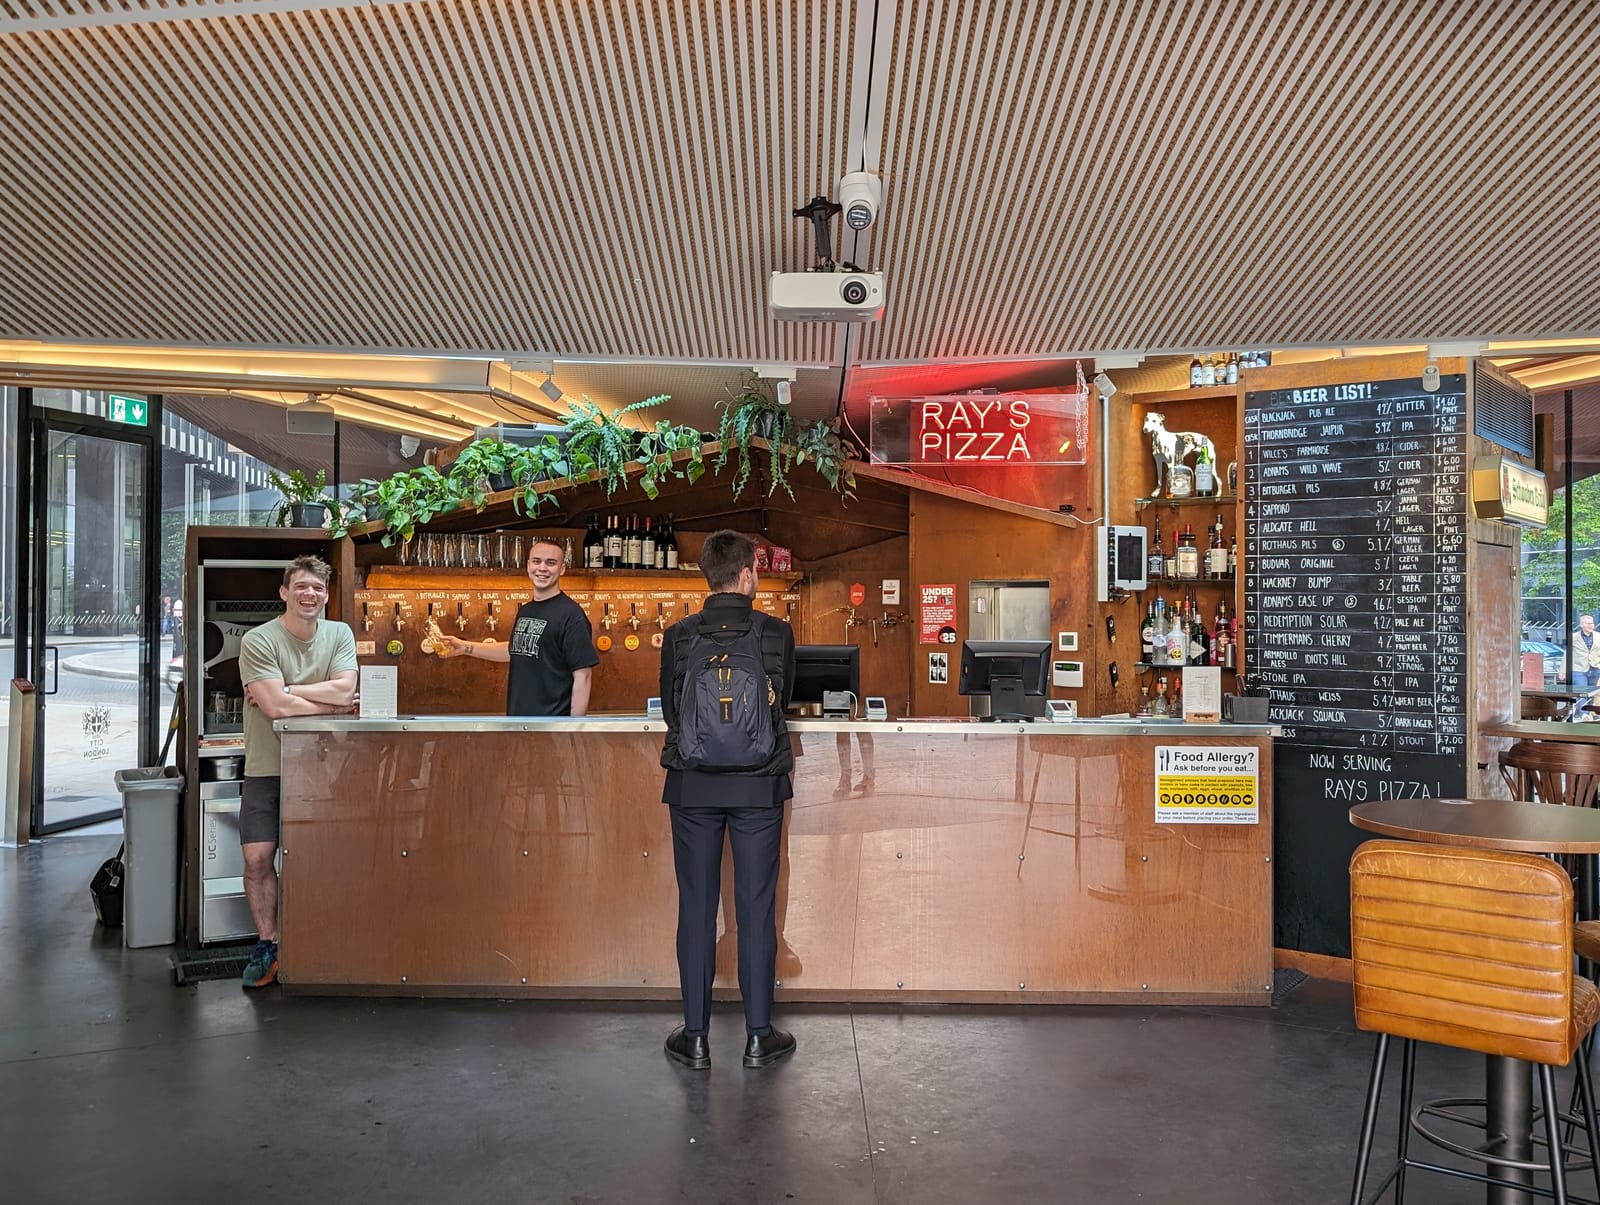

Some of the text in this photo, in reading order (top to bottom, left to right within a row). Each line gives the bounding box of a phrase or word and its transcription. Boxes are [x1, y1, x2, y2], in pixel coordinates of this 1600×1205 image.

[1293, 384, 1372, 404] BEER LIST!
[922, 400, 1031, 429] RAY'S
[1261, 411, 1296, 423] BLACKJACK
[1309, 408, 1322, 418] PUB
[1396, 400, 1425, 412] BITTER
[1261, 427, 1308, 441] THORNBRIDGE
[1401, 421, 1414, 432] IPA
[922, 432, 1031, 460] PIZZA
[1400, 441, 1420, 451] CIDER
[1249, 469, 1255, 479] 2
[1300, 464, 1317, 474] WILD
[1322, 463, 1342, 473] WAVE
[1378, 460, 1390, 473] 5%
[1398, 460, 1421, 470] CIDER
[1249, 486, 1255, 496] 3
[1262, 484, 1297, 496] BITBURGER
[1305, 483, 1320, 494] PILS
[1248, 505, 1255, 517] 4
[1377, 500, 1392, 513] 5%
[1398, 504, 1420, 513] LAGER
[1249, 524, 1255, 535] 5
[1263, 522, 1293, 533] ALDGATE
[1300, 521, 1317, 532] HELL
[1395, 516, 1410, 525] HELL
[1402, 525, 1425, 533] LAGER
[1249, 542, 1255, 551] 6
[1262, 540, 1297, 551] ROTHAUS
[1301, 539, 1317, 550] PILS
[1394, 536, 1420, 544] GERMAN
[1262, 558, 1291, 570] BUDVAR
[1300, 557, 1336, 569] ORIGINAL
[1262, 577, 1297, 589] HACKNEY
[1308, 576, 1332, 589] BUMP
[1378, 578, 1392, 591] 3%
[1401, 575, 1423, 583] TABLE
[1401, 584, 1420, 592] BEER
[922, 587, 953, 596] UNDER
[922, 595, 938, 604] 25?
[1247, 596, 1254, 607] 9
[1263, 595, 1294, 608] ADNAMS
[1298, 595, 1318, 607] EASE
[1322, 595, 1334, 607] UP
[1396, 596, 1427, 604] SESSION
[1407, 604, 1419, 613] IPA
[1246, 615, 1256, 624] 10
[1263, 614, 1312, 628] REDEMPTION
[1320, 614, 1348, 628] SOLAR
[1394, 618, 1410, 627] PALE
[1413, 618, 1425, 627] ALE
[942, 632, 956, 643] 25
[1247, 635, 1254, 644] 11
[1263, 633, 1313, 646] TIMMERMANS
[1321, 634, 1352, 647] CHERRY
[1394, 634, 1420, 642] BELGIAN
[1246, 654, 1255, 663] 12
[1263, 650, 1298, 660] ARMADILLO
[1331, 654, 1348, 665] HILL
[1377, 655, 1392, 668] 9%
[1396, 654, 1420, 663] TEXAS
[1270, 660, 1287, 668] ALES
[1396, 663, 1425, 672] STRONG
[1262, 672, 1289, 683] STONE
[1293, 674, 1307, 684] IPA
[1405, 676, 1419, 688] IPA
[1318, 692, 1342, 702] WEISS
[1394, 697, 1414, 706] WHEAT
[1417, 697, 1433, 708] BEER
[1269, 708, 1304, 721] ACKJACK
[1313, 709, 1347, 722] SQUALOR
[1378, 714, 1393, 728] 5%
[1395, 717, 1411, 726] DARK
[1412, 719, 1433, 729] LAGER
[1399, 736, 1426, 745] STOUT
[1174, 752, 1255, 764] Food Allergy?
[1310, 754, 1392, 772] NOW SERVING
[1325, 778, 1368, 801] RAYS
